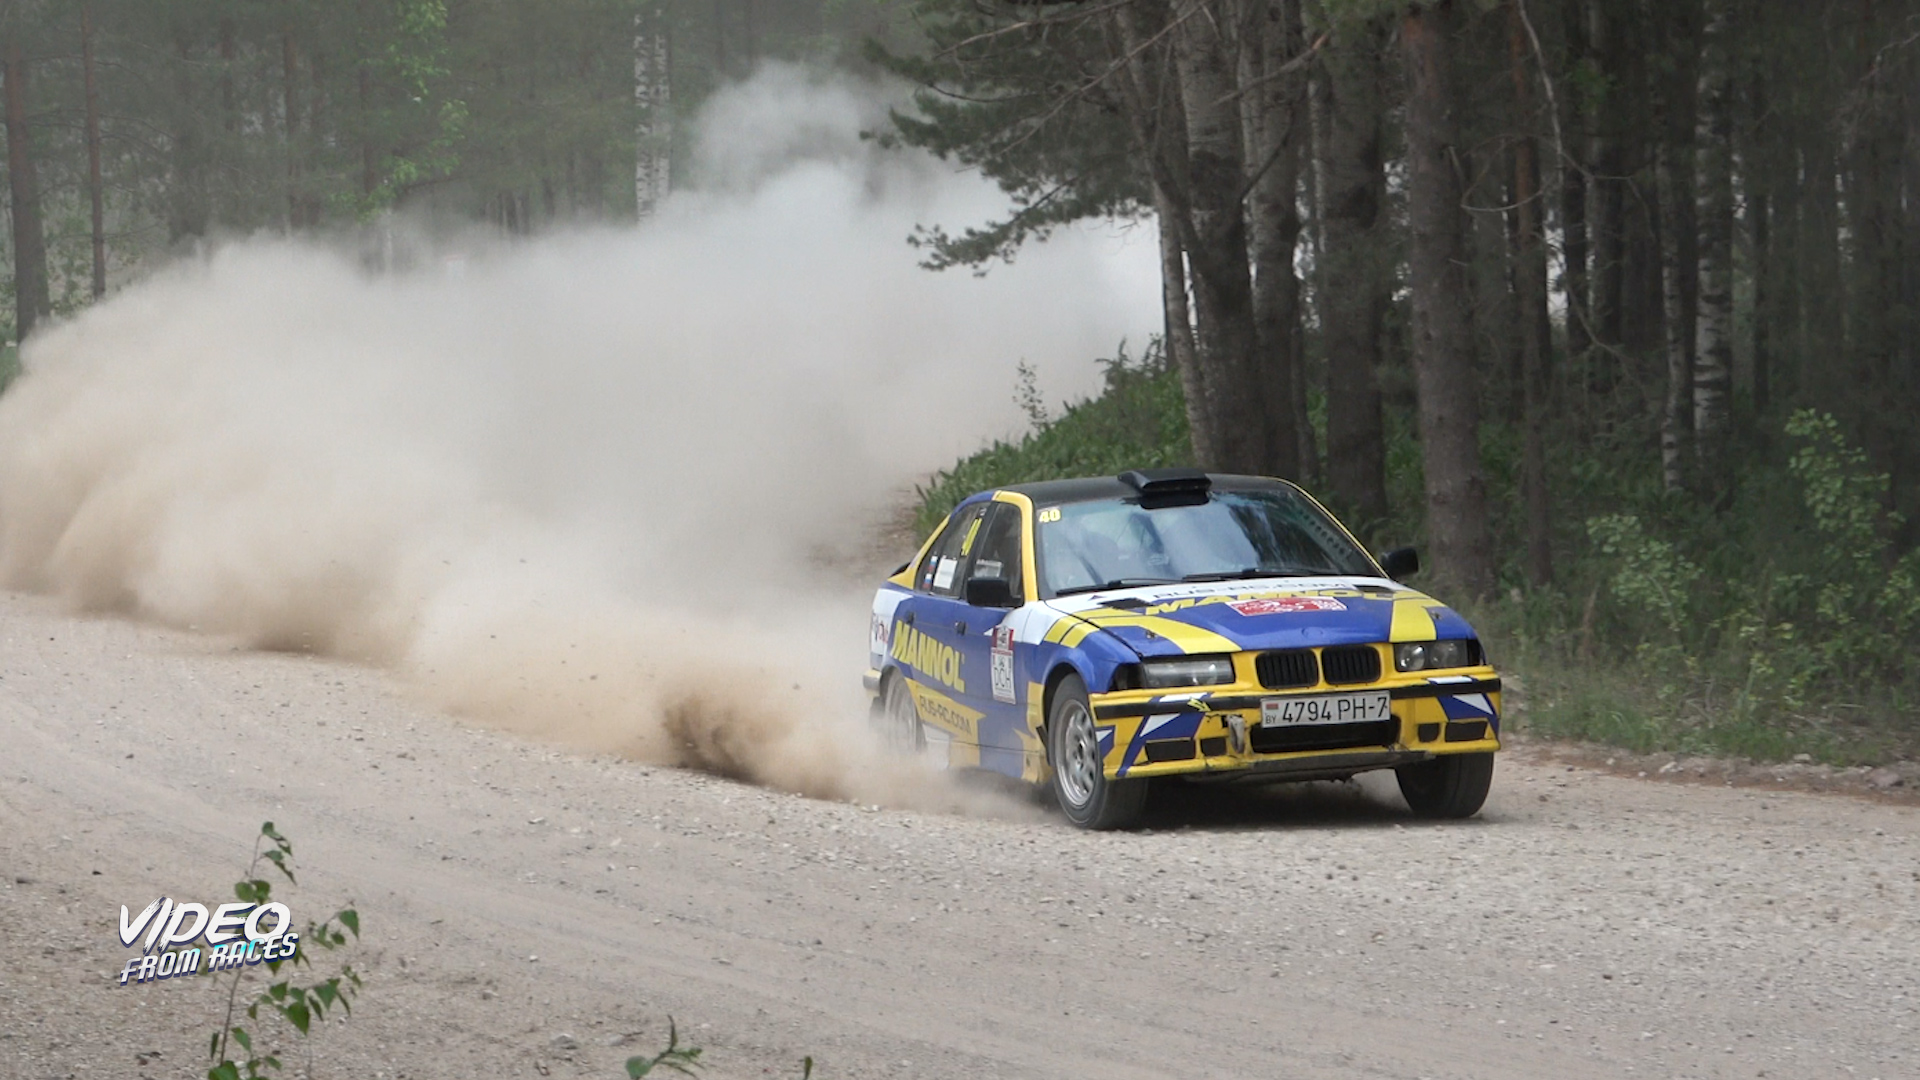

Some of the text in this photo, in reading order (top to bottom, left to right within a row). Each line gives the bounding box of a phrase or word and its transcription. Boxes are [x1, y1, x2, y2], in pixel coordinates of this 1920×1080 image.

[1039, 508, 1061, 523] 40
[1145, 589, 1394, 615] MANNOL
[889, 619, 965, 694] MANNOL
[1265, 714, 1277, 724] BY
[1282, 697, 1388, 723] 4794 PH-7
